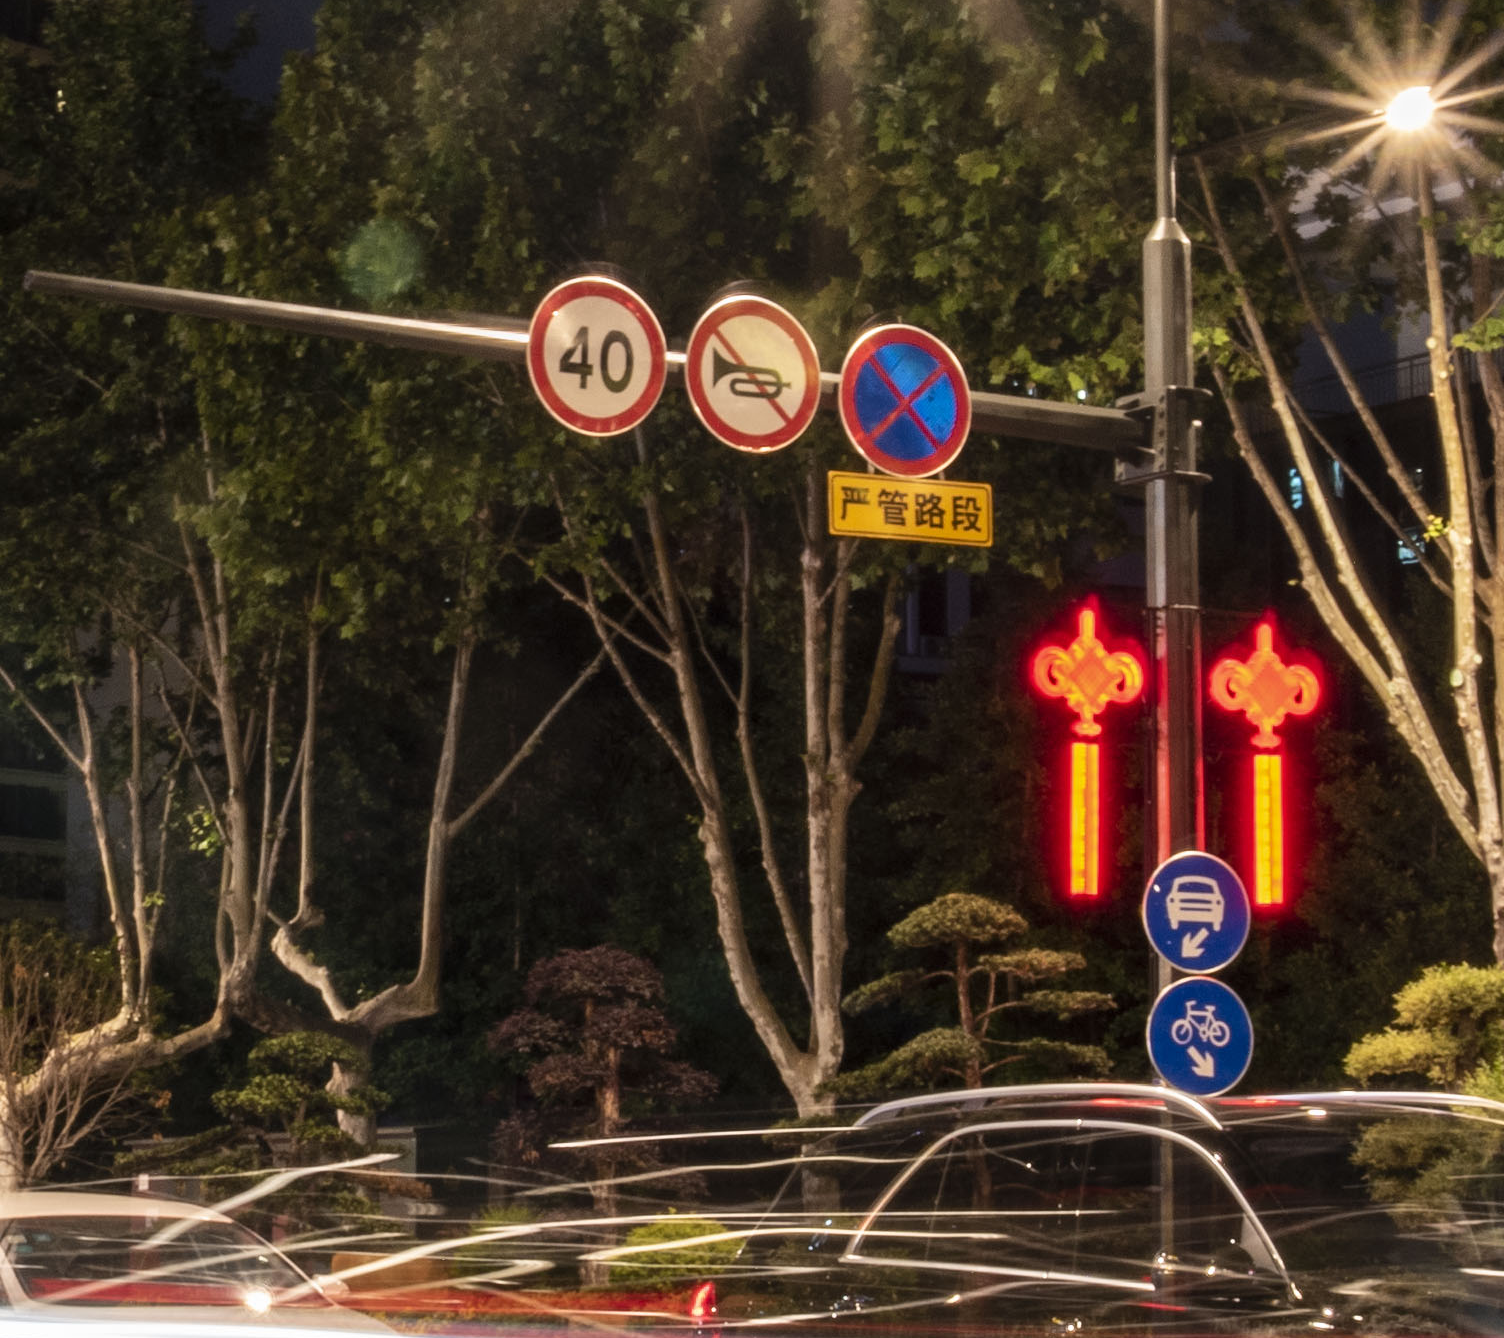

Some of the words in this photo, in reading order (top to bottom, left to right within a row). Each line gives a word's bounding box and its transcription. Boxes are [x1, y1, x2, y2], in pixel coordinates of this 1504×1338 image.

[559, 326, 634, 394] 40
[840, 485, 982, 533] 严管路段
